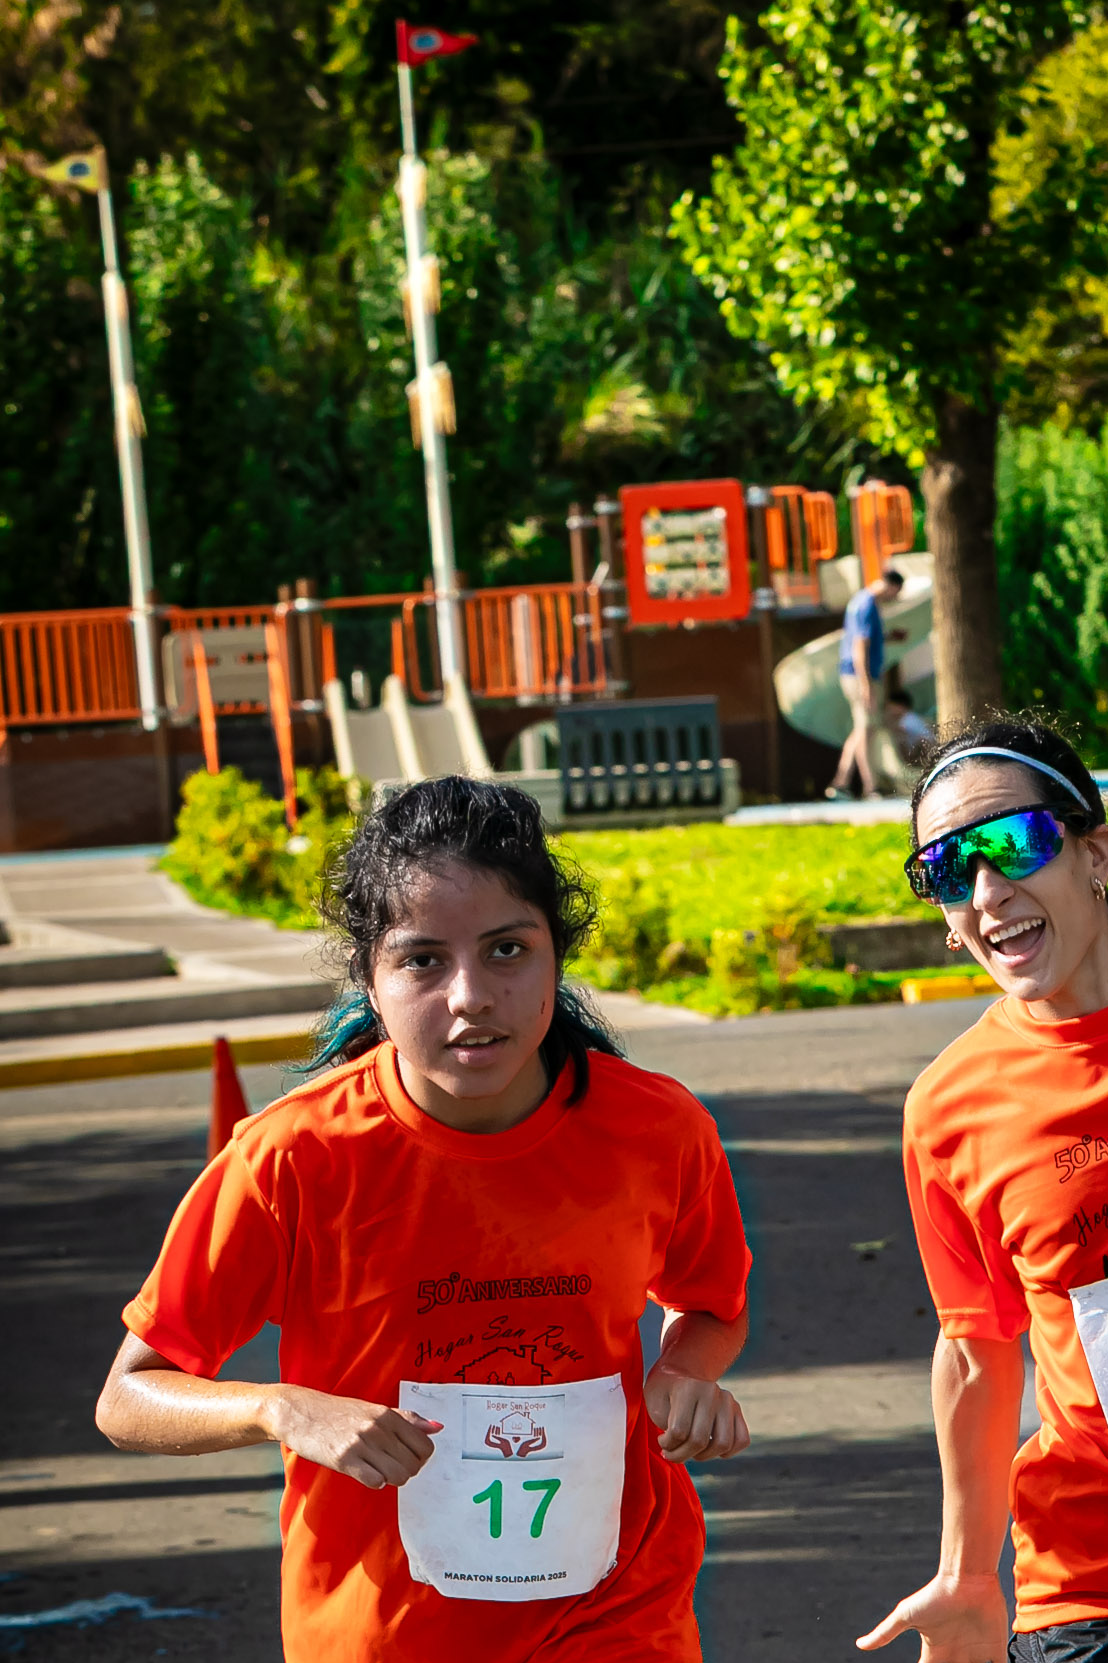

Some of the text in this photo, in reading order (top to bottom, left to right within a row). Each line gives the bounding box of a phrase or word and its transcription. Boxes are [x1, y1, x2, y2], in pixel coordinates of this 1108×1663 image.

[457, 1274, 592, 1304] ANIVERSARIO
[414, 1315, 585, 1367] Hogar San Roque
[510, 1401, 523, 1411] San
[524, 1401, 546, 1411] Roque
[472, 1478, 562, 1539] 17
[444, 1571, 567, 1583] MARATON SOLIDARIA 2025
